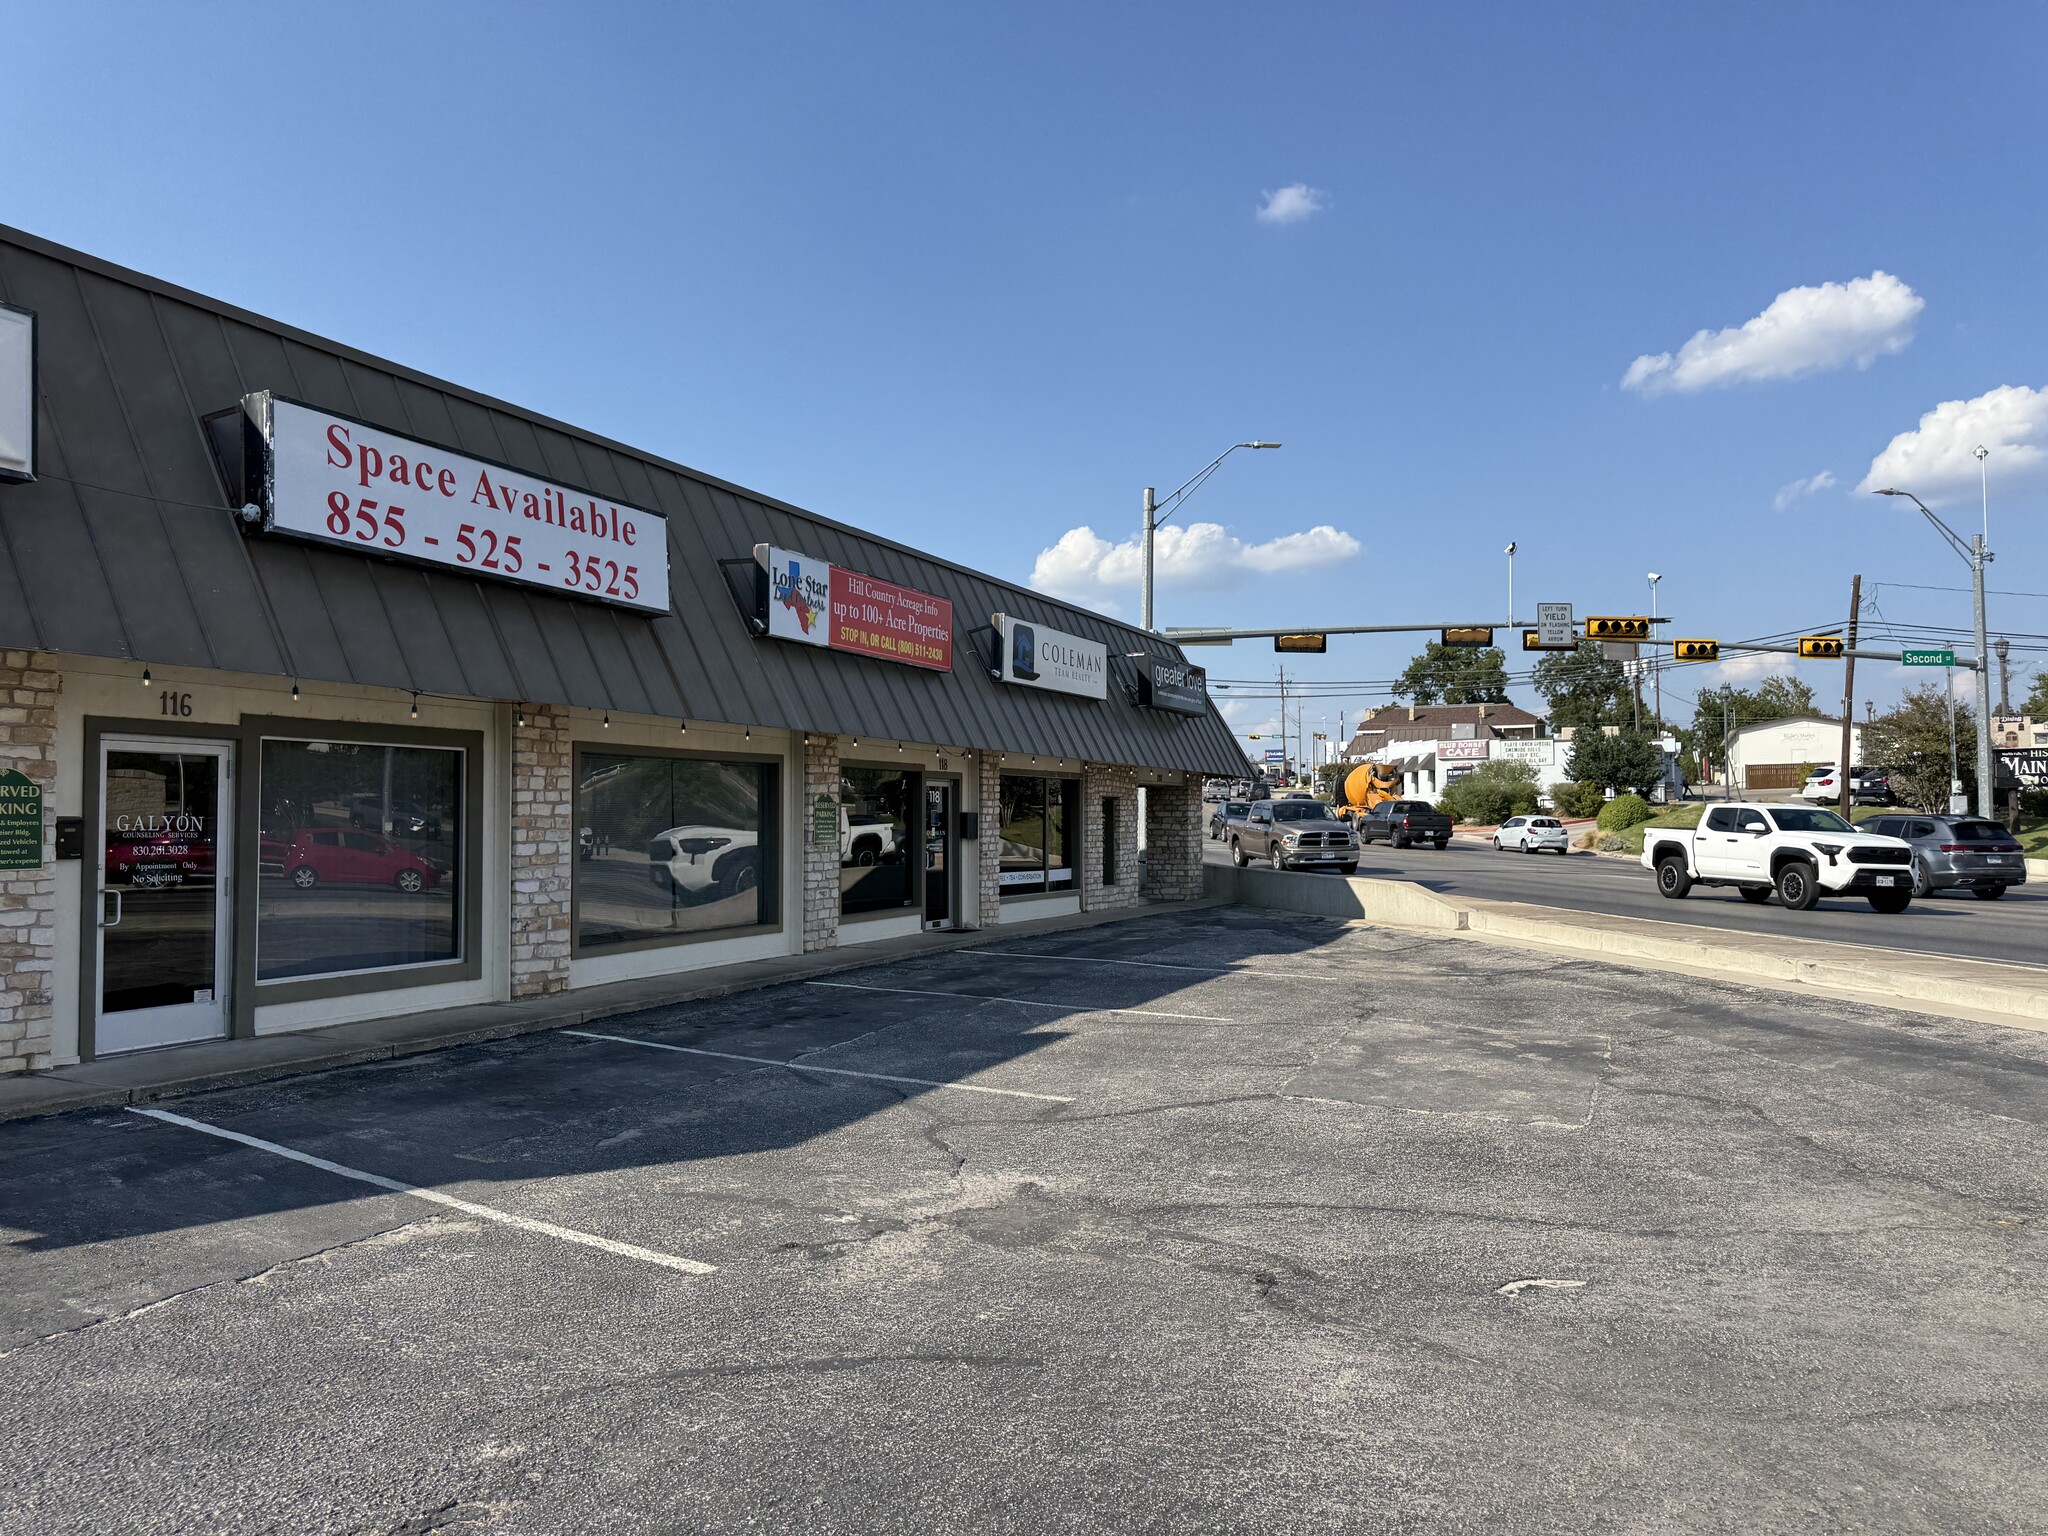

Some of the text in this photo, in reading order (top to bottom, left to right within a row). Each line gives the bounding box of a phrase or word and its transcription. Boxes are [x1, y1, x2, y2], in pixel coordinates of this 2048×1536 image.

[327, 424, 637, 546] Space Available
[326, 491, 406, 547] 855
[456, 523, 522, 573] 525
[564, 550, 639, 599] 3525
[773, 567, 828, 597] Lone Star
[848, 577, 938, 616] Hill Country Acreage Info
[832, 602, 949, 642] up to 100+ Acre Properties
[841, 626, 943, 661] STOP IN, OR CALL (800) 511-2430
[1042, 642, 1101, 672] COLEMAN
[1906, 653, 1942, 663] Second
[1055, 667, 1070, 678] TEAM
[1155, 665, 1202, 692] greater love
[160, 691, 192, 717] 116
[1445, 748, 1480, 757] CAFE
[939, 758, 948, 770] 118
[2001, 757, 2047, 775] MAIN
[929, 790, 940, 803] 118
[7, 820, 39, 828] Employees
[116, 815, 205, 832] GALYON
[15, 829, 31, 837] Bldg.
[120, 861, 198, 871] By Appointment Only
[132, 872, 183, 883] No Soliciting
